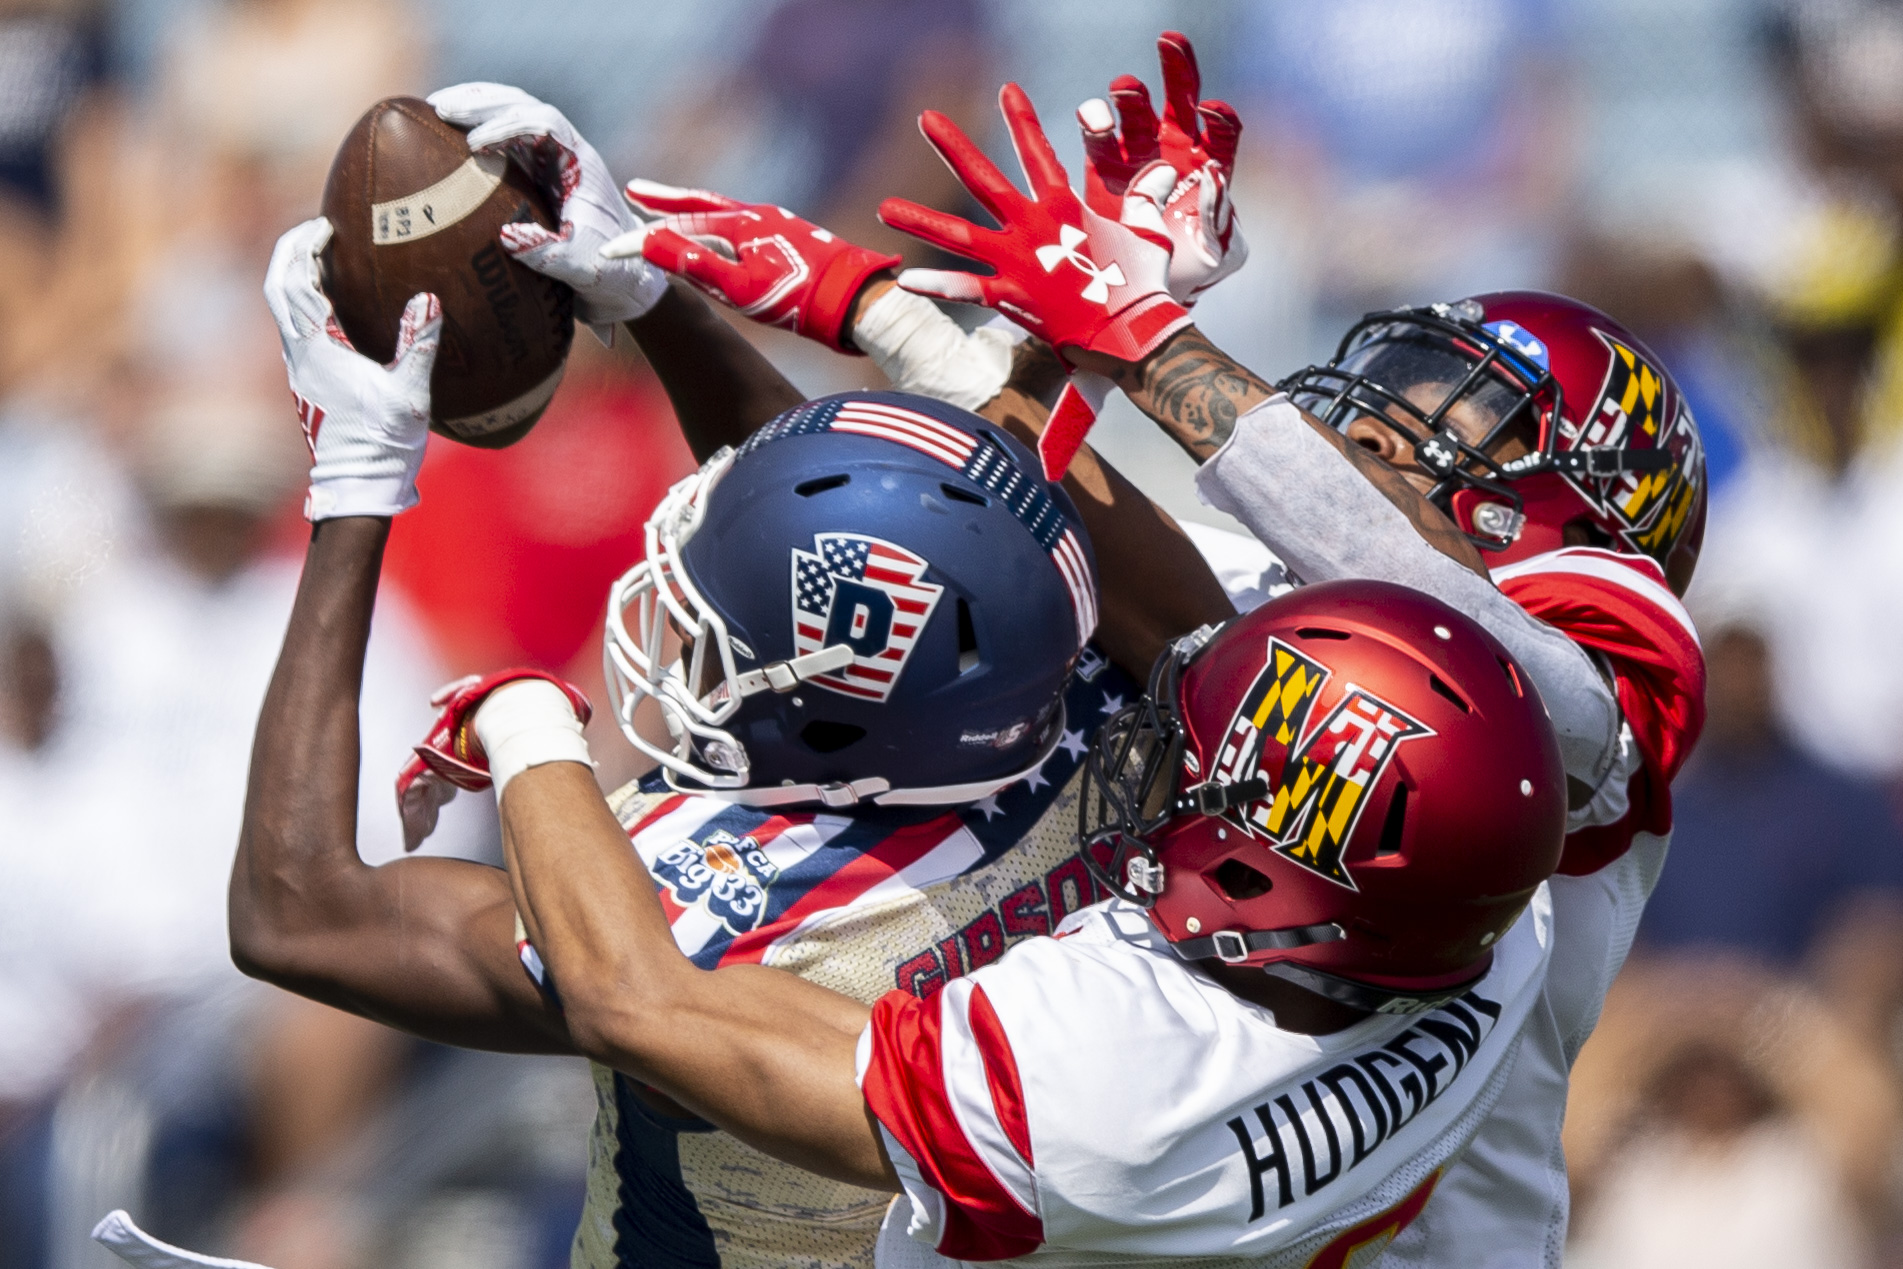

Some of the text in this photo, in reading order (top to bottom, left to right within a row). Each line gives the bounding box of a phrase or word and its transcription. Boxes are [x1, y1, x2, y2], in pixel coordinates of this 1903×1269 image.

[1187, 636, 1438, 892] M
[657, 841, 762, 916] Big 33
